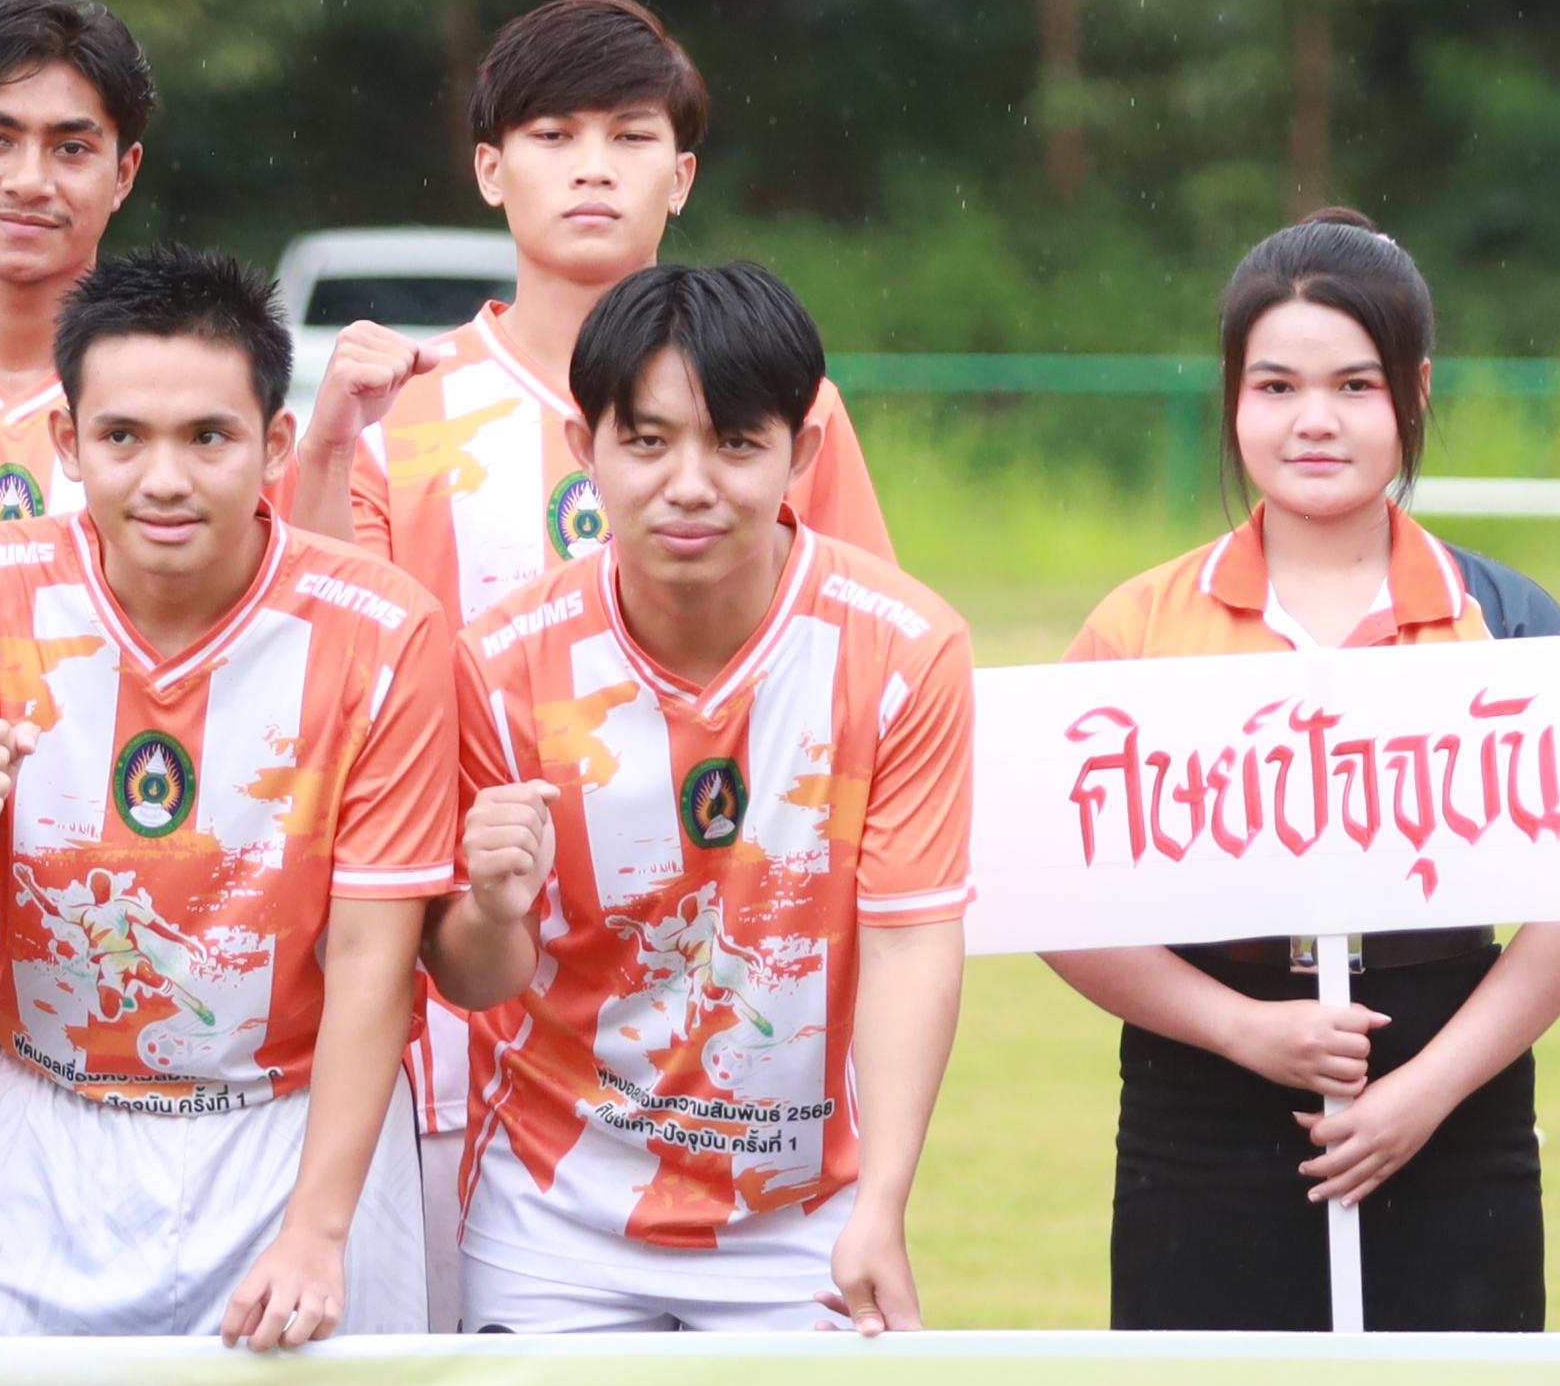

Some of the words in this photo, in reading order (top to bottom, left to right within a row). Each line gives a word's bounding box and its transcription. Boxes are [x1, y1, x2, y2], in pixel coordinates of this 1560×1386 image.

[295, 571, 408, 630] COMTMS
[481, 589, 584, 659] KPRUMS
[820, 572, 931, 639] COMTMS
[732, 1127, 783, 1154] ครั้งที่
[788, 1137, 798, 1151] 1
[786, 1102, 834, 1122] 2568
